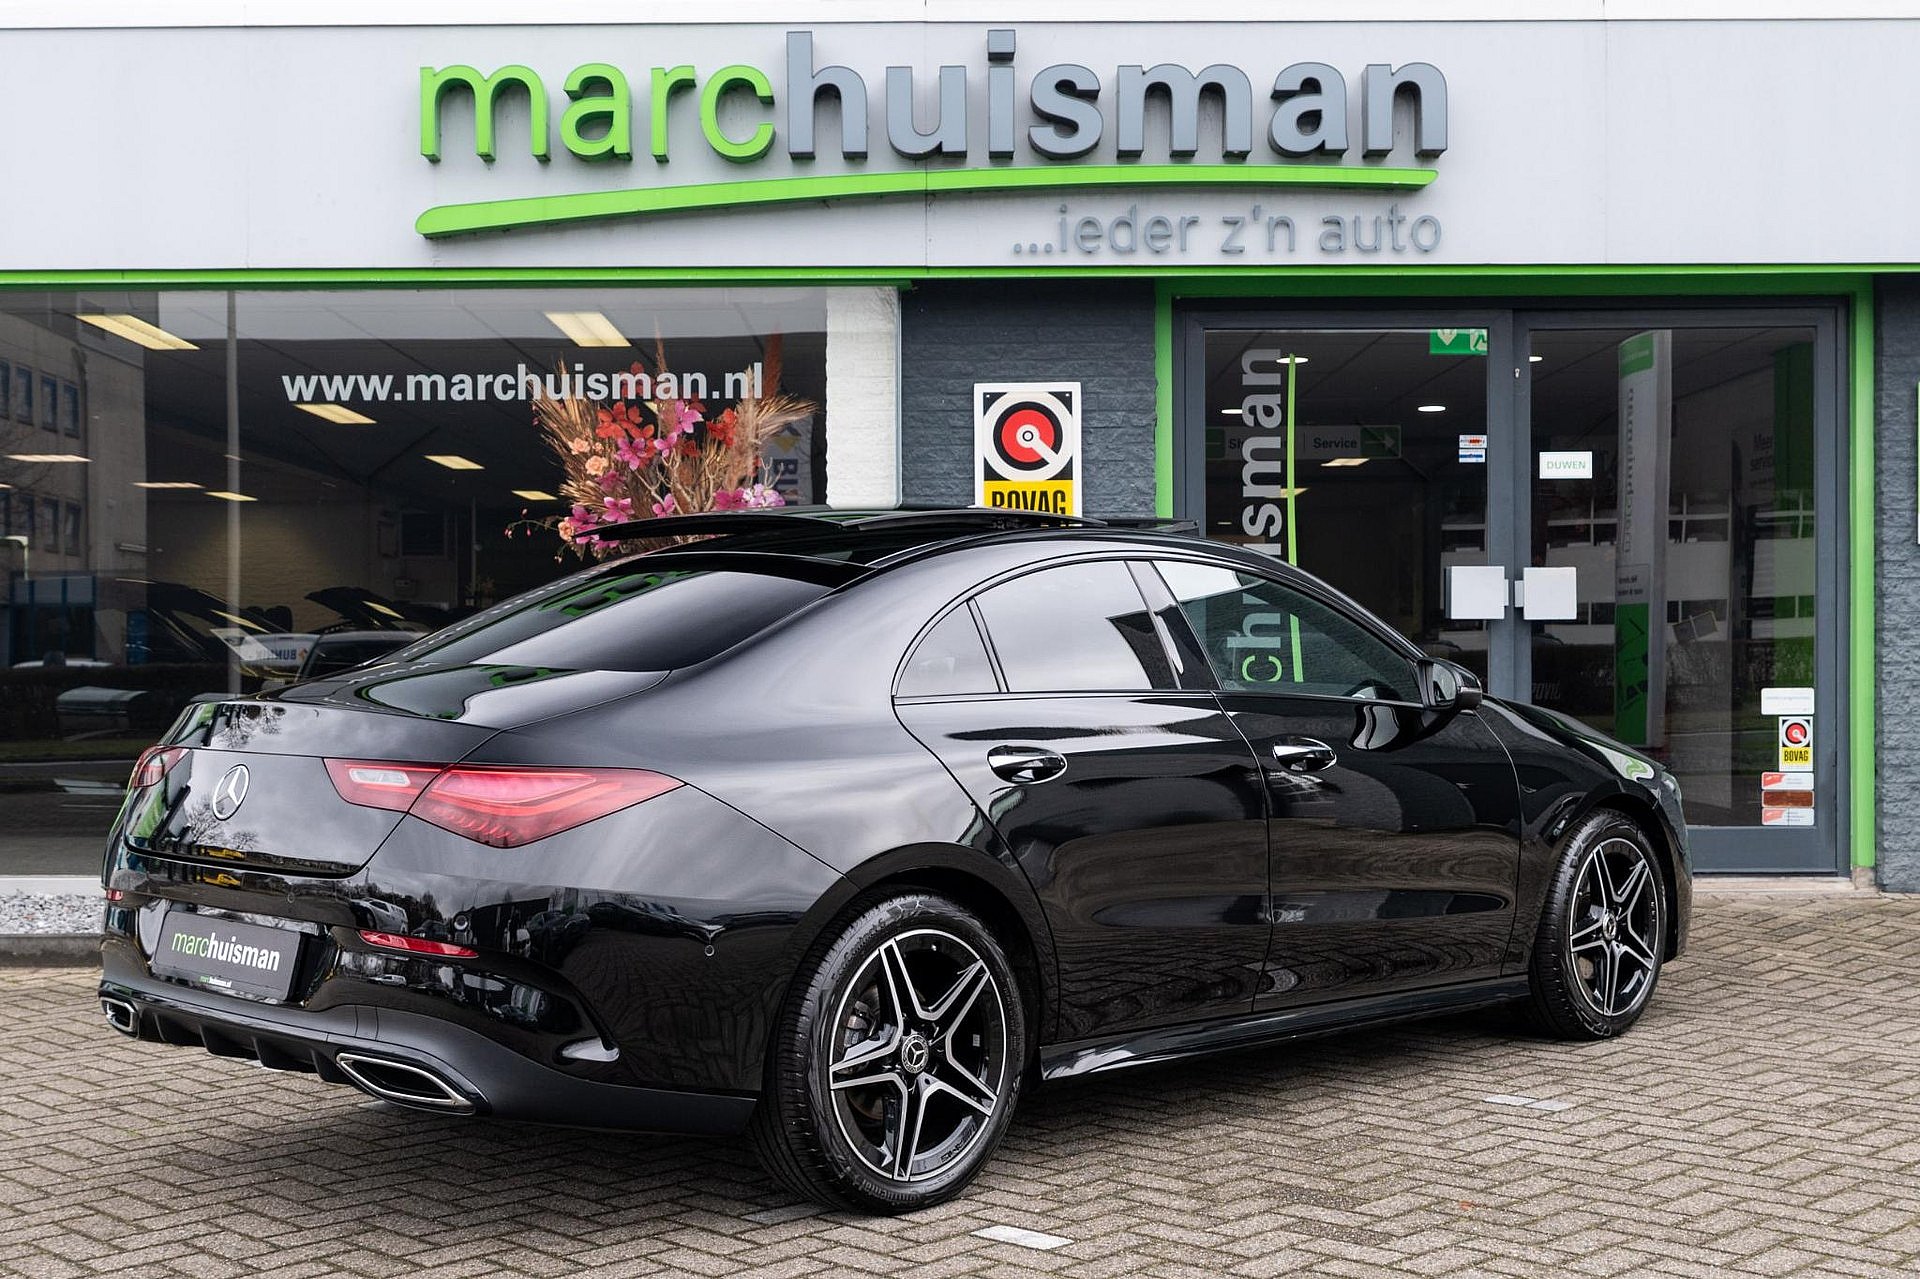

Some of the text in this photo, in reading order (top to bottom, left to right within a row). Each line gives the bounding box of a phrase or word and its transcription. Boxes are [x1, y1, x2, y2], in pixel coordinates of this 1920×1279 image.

[419, 30, 1448, 163] marchuisman
[1221, 204, 1296, 254] z'n
[1319, 203, 1442, 253] auto
[281, 362, 763, 401] www.marchuisman.nl
[1313, 437, 1358, 450] Service
[1783, 750, 1809, 762] BOVAG
[171, 932, 281, 972] marchuisman
